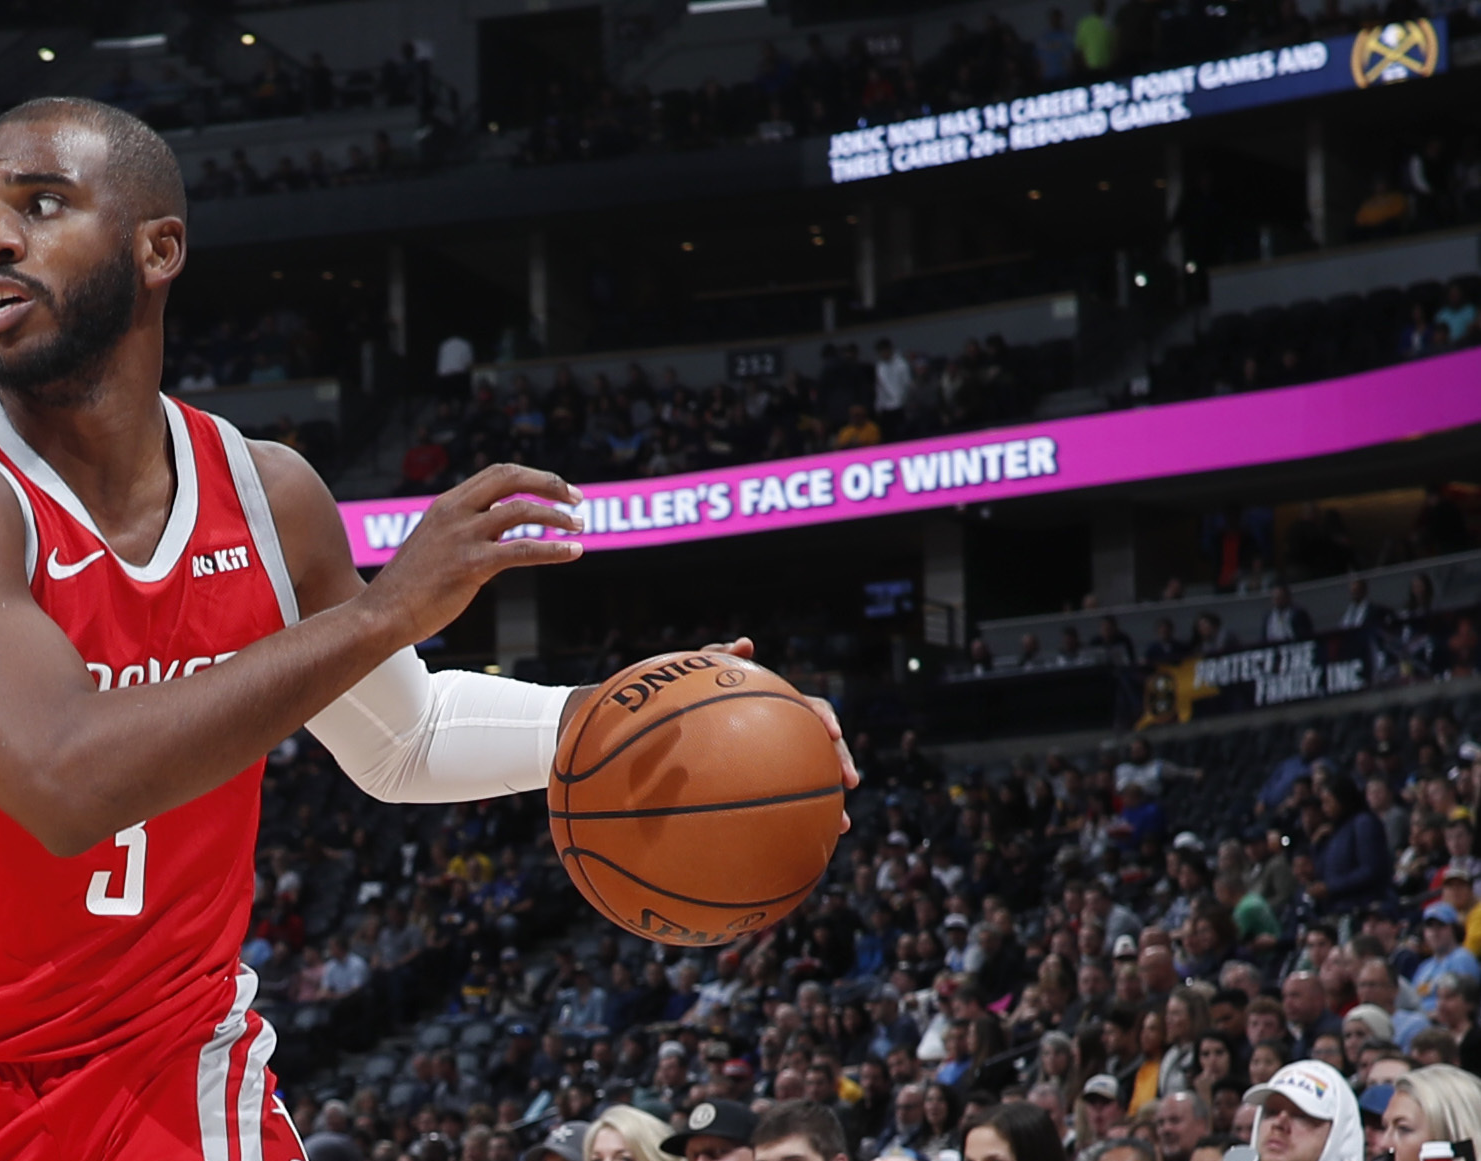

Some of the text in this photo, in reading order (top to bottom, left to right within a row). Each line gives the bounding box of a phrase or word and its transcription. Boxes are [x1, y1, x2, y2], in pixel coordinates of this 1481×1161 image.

[938, 107, 982, 137] HAS
[1010, 87, 1088, 124] CAREER
[1132, 66, 1196, 100] POINT
[1198, 50, 1276, 90] GAMES
[1277, 41, 1328, 75] AND
[829, 151, 891, 183] THREE
[892, 135, 968, 172] CAREER
[1009, 110, 1108, 151] REBOUND
[739, 468, 834, 515] FACE
[841, 459, 895, 501] OF
[899, 437, 1057, 493] WINTER
